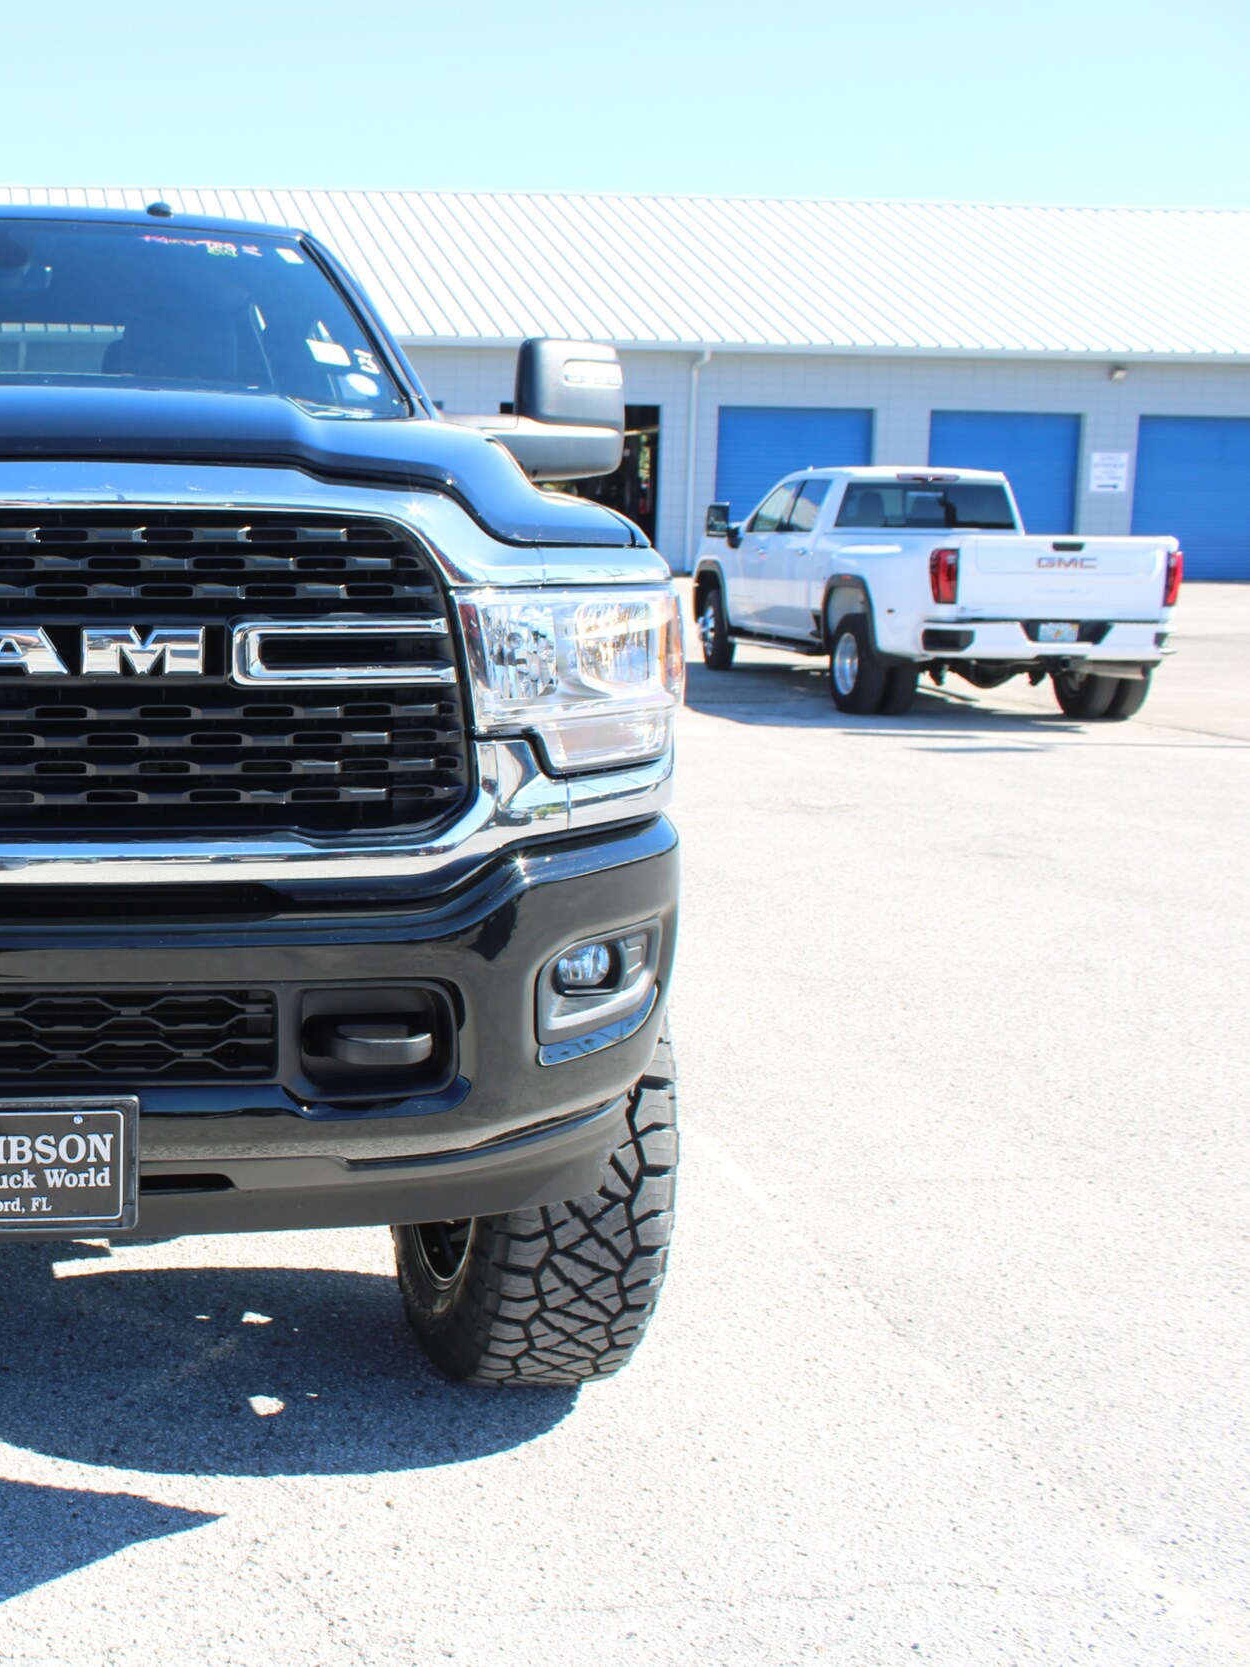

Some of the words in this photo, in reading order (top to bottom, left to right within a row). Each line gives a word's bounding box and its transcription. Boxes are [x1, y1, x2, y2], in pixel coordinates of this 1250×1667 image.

[1036, 556, 1098, 570] GMC
[44, 1167, 112, 1188] World
[31, 1196, 52, 1212] FL
